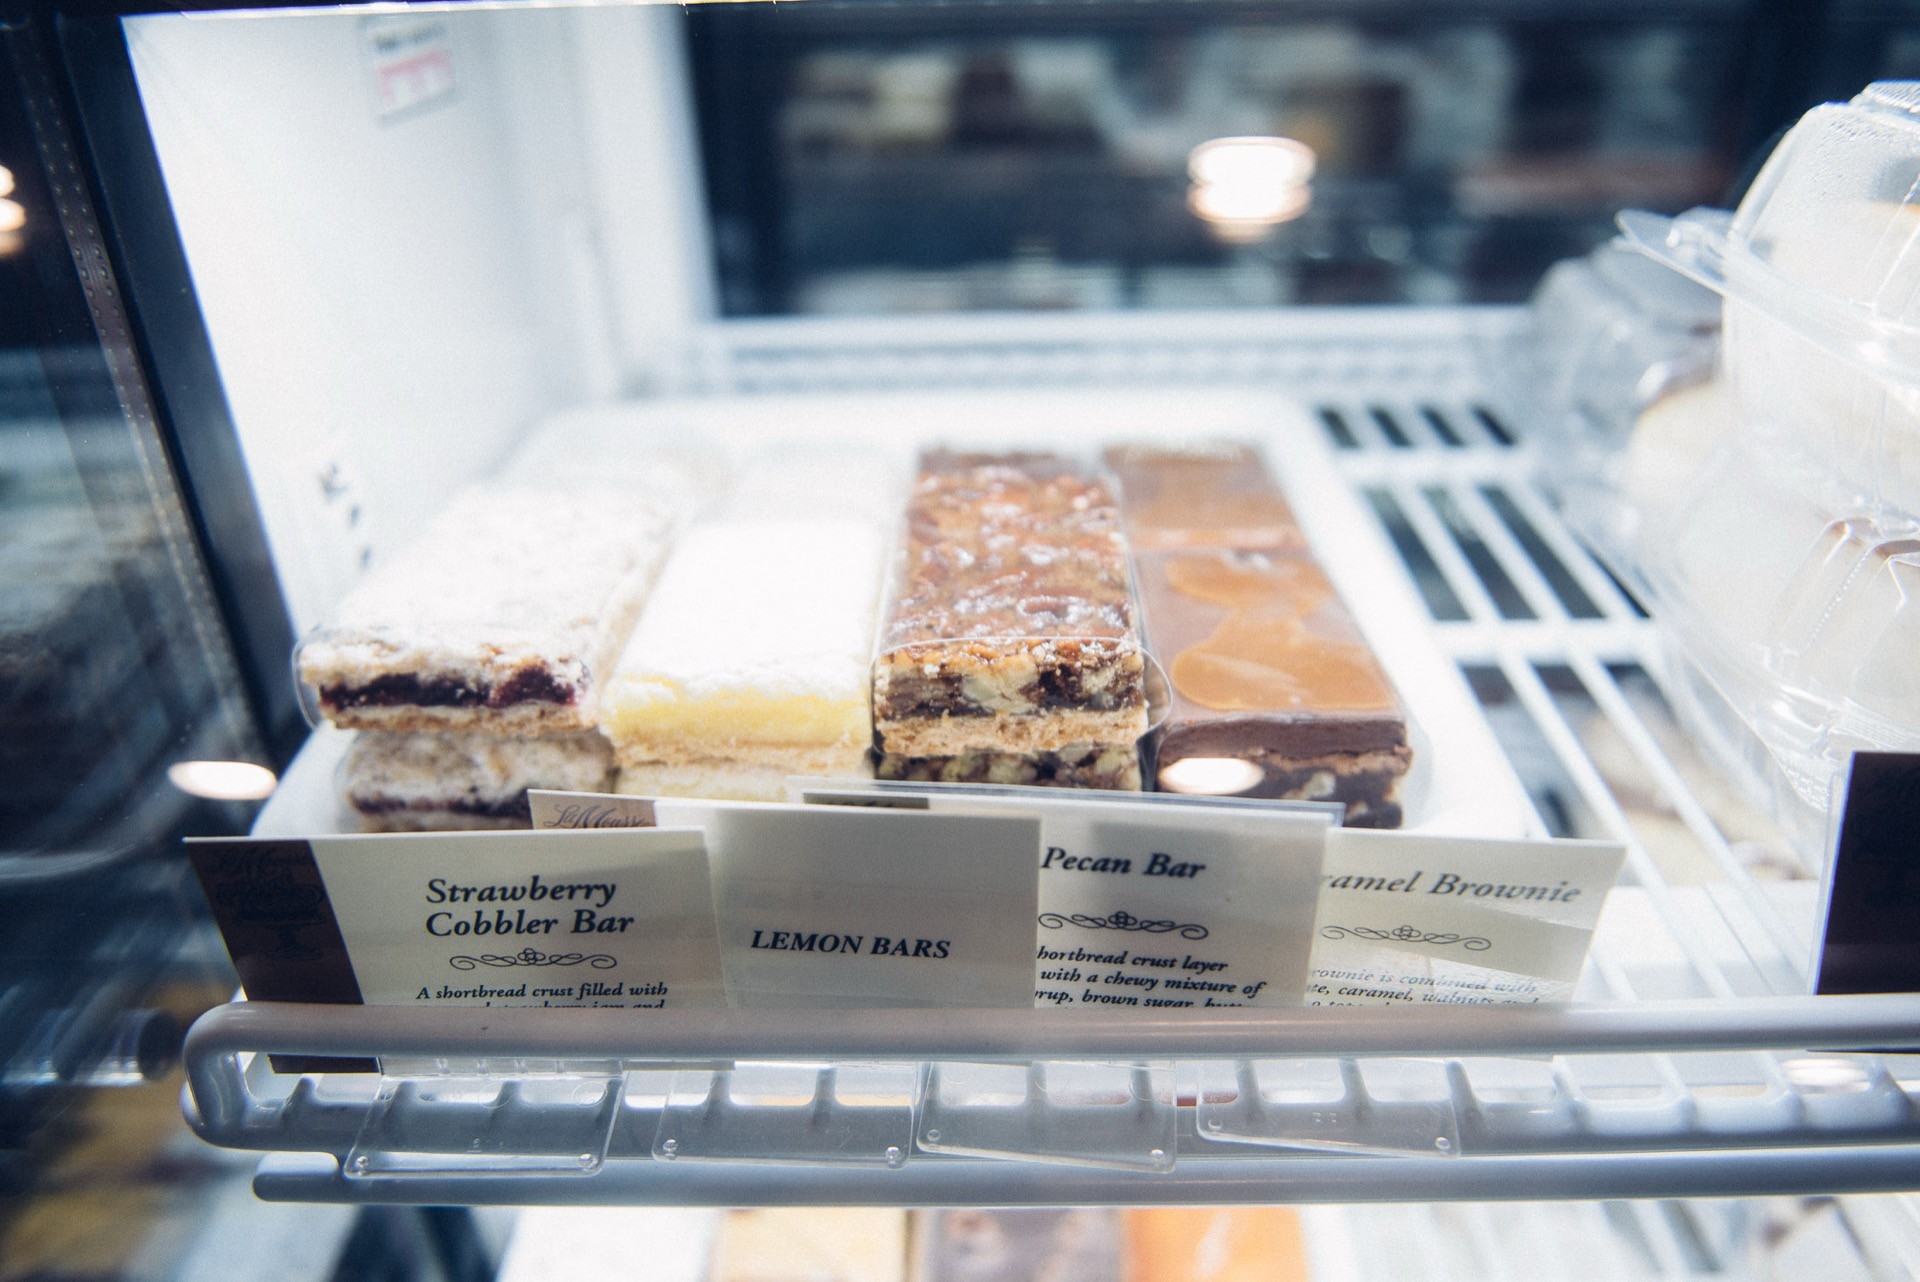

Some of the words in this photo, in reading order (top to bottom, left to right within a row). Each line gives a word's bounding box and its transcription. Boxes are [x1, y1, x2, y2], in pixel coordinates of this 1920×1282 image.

[1041, 846, 1132, 874] Pecan
[1143, 853, 1206, 878] Bar
[426, 875, 616, 908] Strawberry
[1322, 871, 1423, 893] amel
[1428, 873, 1582, 903] Brownie
[426, 909, 558, 936] Cobbler
[570, 909, 634, 934] Bar
[751, 930, 863, 954] LEMON
[871, 936, 950, 959] BARS
[1037, 945, 1128, 965] hortbread
[1132, 953, 1178, 969] crust
[1182, 955, 1228, 975] layer
[1041, 968, 1081, 982] with
[1086, 974, 1098, 983] a
[1105, 970, 1159, 990] chewy
[1165, 977, 1237, 994] mixture
[1242, 981, 1267, 999] of
[1310, 969, 1374, 981] rownie
[1380, 970, 1395, 982] is
[416, 987, 430, 999] A
[436, 984, 526, 999] shortbread
[532, 986, 574, 997] crust
[577, 983, 623, 1000] filled
[629, 982, 668, 996] with
[1082, 989, 1138, 1006] brown
[1338, 985, 1414, 1001] caramel,
